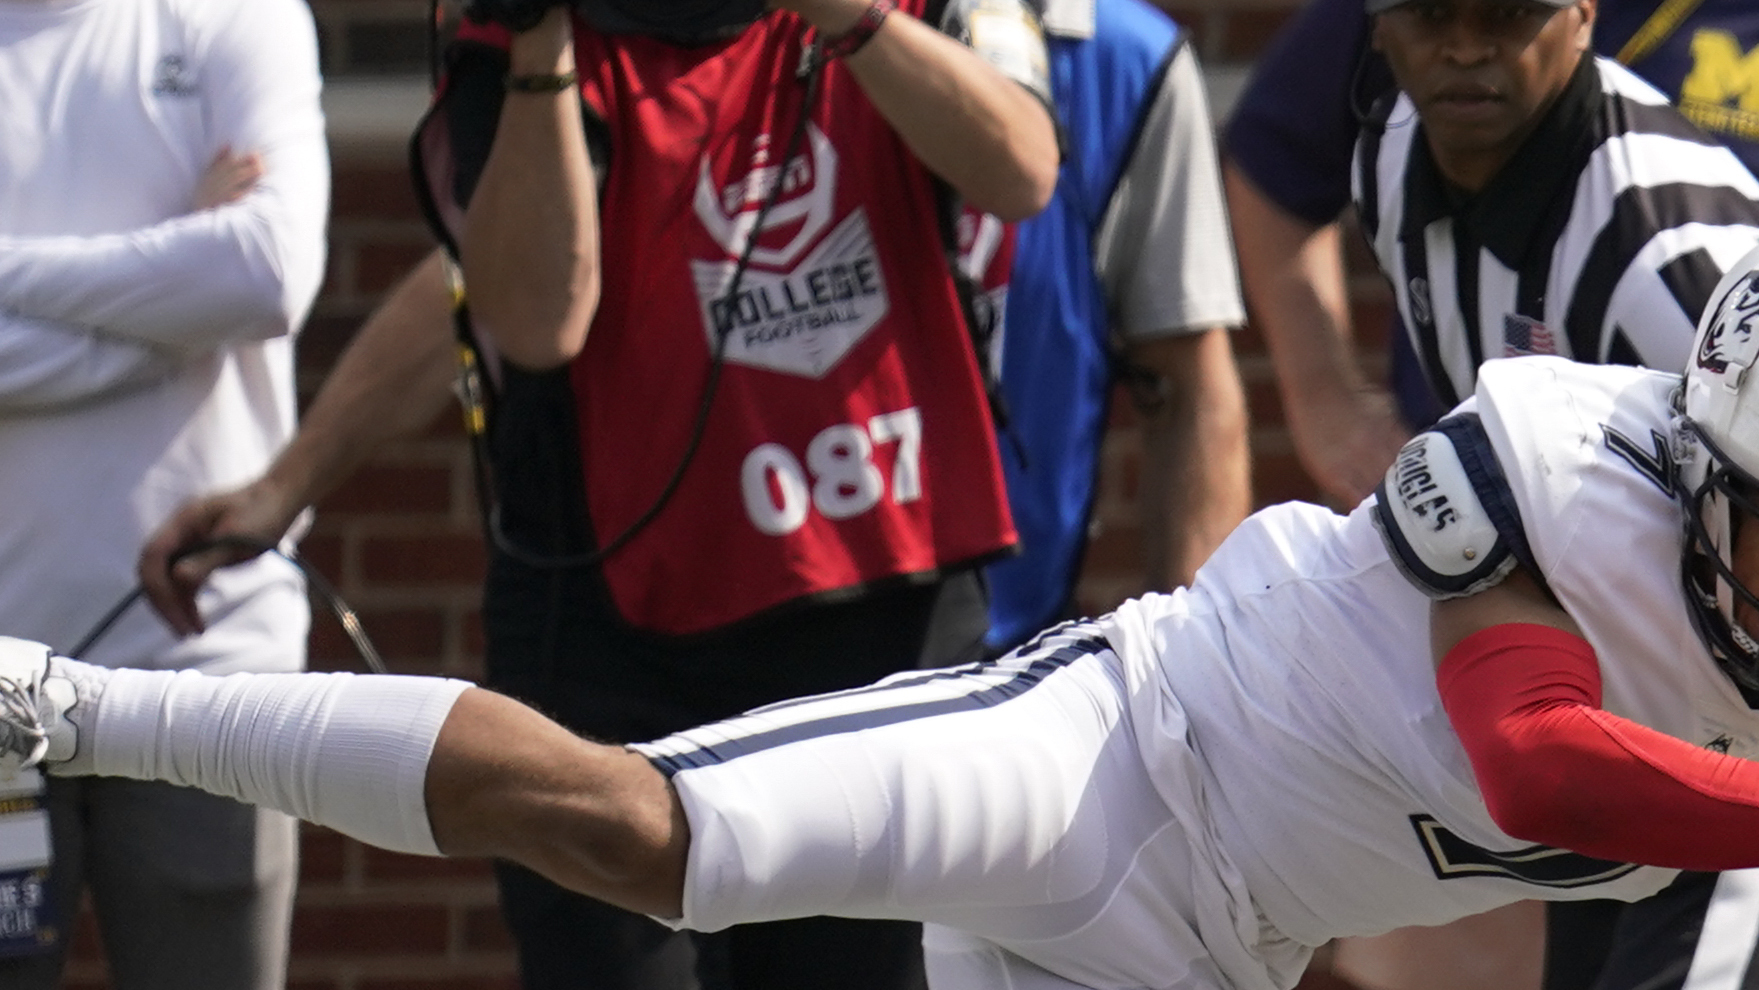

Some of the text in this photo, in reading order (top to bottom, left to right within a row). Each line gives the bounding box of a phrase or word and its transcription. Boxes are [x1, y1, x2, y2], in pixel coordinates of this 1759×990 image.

[709, 258, 878, 334] COLLEGE
[743, 308, 862, 348] FOOTBALL
[740, 406, 922, 537] 087
[1598, 422, 1675, 500] 7
